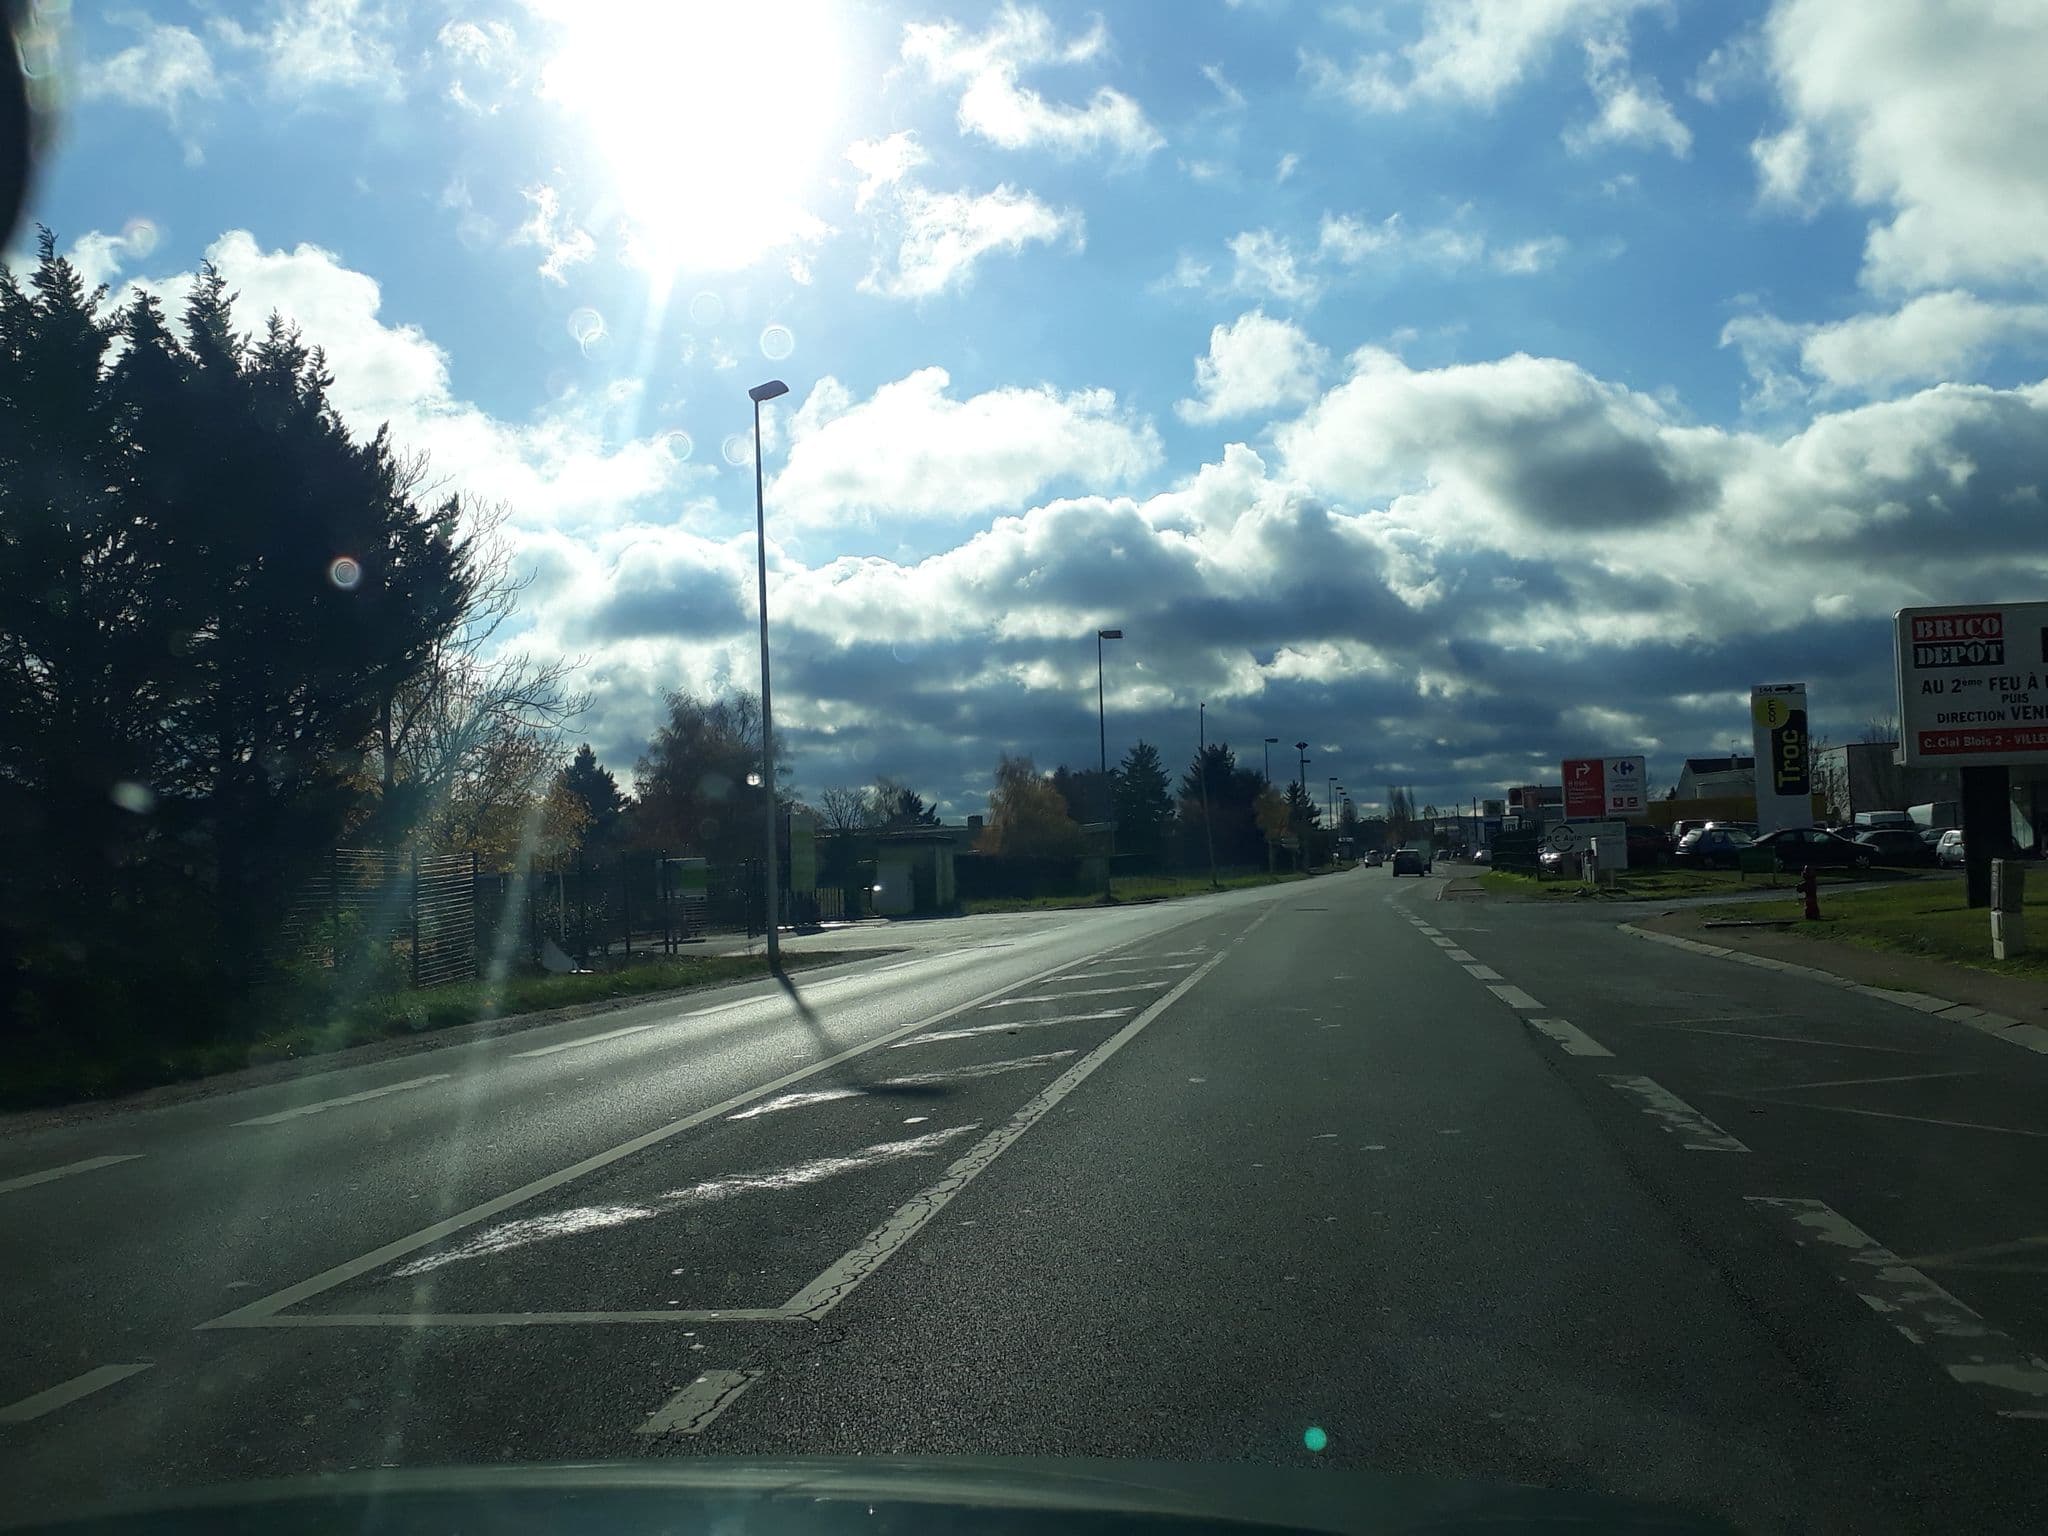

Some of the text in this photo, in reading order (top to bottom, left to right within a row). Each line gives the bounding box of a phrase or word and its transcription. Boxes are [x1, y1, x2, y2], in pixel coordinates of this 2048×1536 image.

[1915, 617, 2001, 638] BRICO
[1921, 679, 1944, 695] AU
[1989, 676, 2020, 691] FEU
[2027, 672, 2038, 690] À
[2002, 693, 2029, 704] PUIS
[1937, 710, 2005, 723] DIRECTION
[1964, 735, 1992, 747] Blois
[1995, 735, 2002, 745] 2
[1777, 728, 1801, 788] Troc
